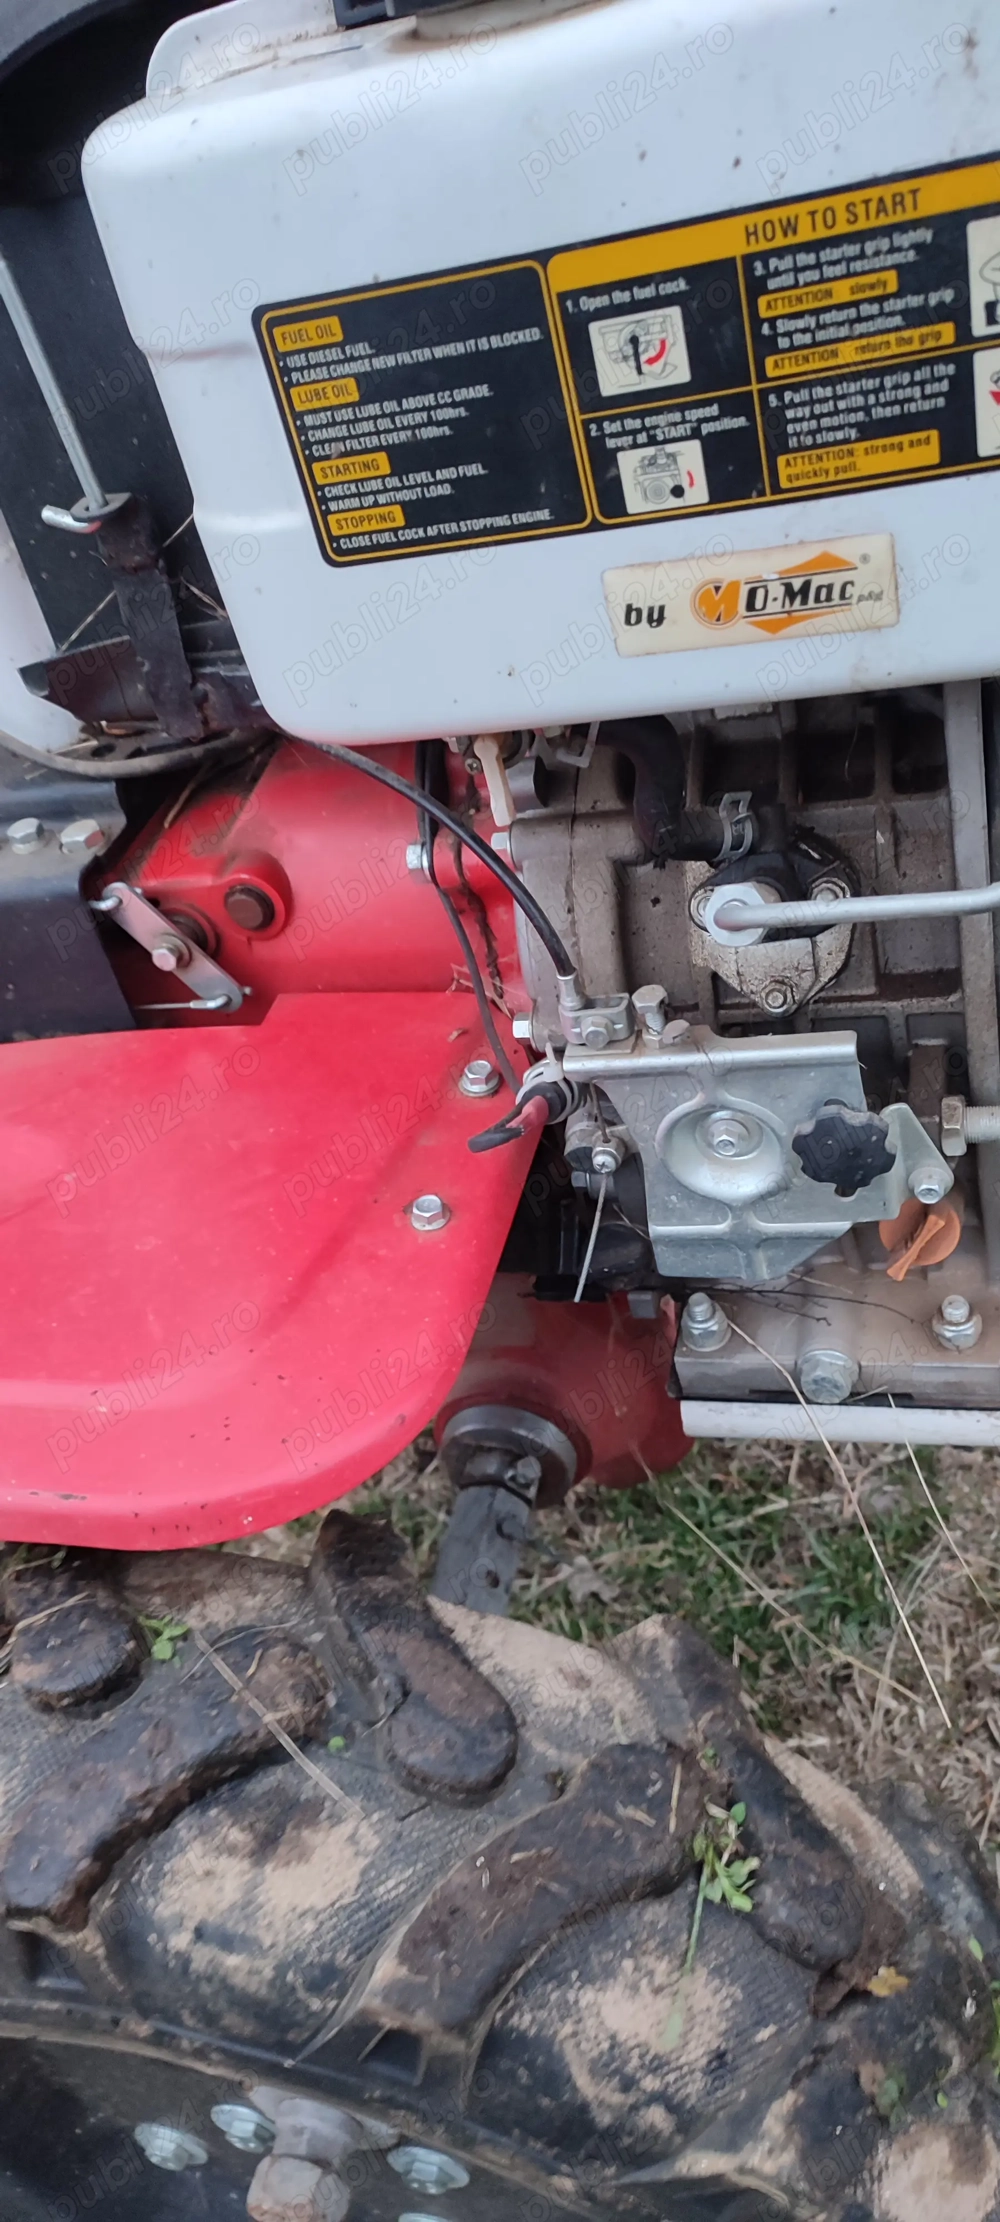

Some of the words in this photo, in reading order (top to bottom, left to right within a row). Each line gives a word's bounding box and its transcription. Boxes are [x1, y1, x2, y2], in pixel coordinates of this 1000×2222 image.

[745, 214, 799, 247] HOW
[807, 206, 837, 232] TO
[845, 188, 921, 225] START
[753, 260, 766, 277] 3.
[768, 254, 794, 273] Pull
[795, 252, 817, 266] the
[819, 243, 862, 263] starter
[864, 236, 891, 255] grip
[766, 271, 795, 290] until
[797, 269, 821, 287] you
[822, 260, 848, 279] feel
[566, 299, 578, 314] 1.
[579, 294, 611, 312] Open
[611, 290, 631, 305] the
[633, 283, 656, 300] fuel
[765, 287, 833, 312] ATTENTION
[849, 278, 888, 296] slowly
[761, 322, 774, 336] 4.
[776, 314, 817, 334] Slowly
[819, 307, 858, 325] return
[859, 302, 881, 317] the
[882, 294, 925, 313] starter
[927, 288, 955, 307] grip
[281, 328, 313, 346] FUEL
[315, 324, 337, 339] OIL
[772, 347, 839, 371] ATTENTION
[854, 338, 891, 355] return
[918, 328, 942, 346] grip
[777, 335, 790, 349] to
[792, 331, 813, 347] the
[814, 323, 850, 342] initial
[286, 353, 306, 368] USE
[308, 347, 345, 364] DIESEL
[344, 342, 376, 358] FUEL.
[291, 365, 329, 384] PLEASE
[329, 359, 372, 377] CHANGE
[371, 354, 396, 369] NEW
[396, 348, 432, 365] FILTER
[432, 342, 465, 359] WHEN
[465, 339, 476, 353] IT
[477, 336, 489, 351] IS
[490, 327, 544, 349] BLOCKED.
[297, 388, 330, 404] LUBE
[332, 384, 353, 398] OIL
[784, 389, 810, 405] Pull
[812, 383, 834, 400] the
[835, 376, 881, 397] starter
[883, 371, 911, 390] grip
[913, 366, 932, 382] all
[933, 362, 956, 378] the
[785, 405, 811, 420] way
[813, 400, 835, 415] out
[836, 394, 865, 411] with
[867, 394, 877, 405] a
[878, 383, 922, 403] strong
[924, 378, 950, 396] and
[303, 411, 333, 427] MUST
[334, 407, 354, 421] USE
[355, 403, 382, 419] LUBE
[383, 400, 400, 414] OIL
[402, 393, 437, 410] ABOVE
[437, 390, 452, 404] CC
[453, 384, 494, 402] GRADE.
[589, 424, 602, 437] 2.
[603, 420, 622, 435] Set
[624, 418, 642, 431] the
[644, 410, 683, 427] engine
[684, 403, 719, 421] speed
[786, 418, 818, 434] even
[871, 403, 902, 420] then
[903, 396, 946, 414] return
[308, 425, 349, 442] CHANGE
[349, 421, 376, 439] LUBE
[377, 417, 394, 431] OIL
[395, 411, 428, 428] EVERY
[345, 435, 380, 450] FILTER
[380, 430, 413, 446] EVERY
[605, 434, 634, 449] lever
[636, 431, 648, 444] at
[701, 416, 751, 436] position.
[788, 436, 799, 449] it
[863, 439, 904, 456] strong
[908, 434, 931, 448] and
[320, 458, 380, 479] STARTING
[324, 482, 358, 498] CHECK
[358, 478, 384, 493] LUBE
[384, 476, 402, 488] OIL
[403, 471, 434, 486] LEVEL
[435, 467, 458, 481] AND
[458, 463, 489, 478] FUEL.
[786, 465, 829, 484] quickly
[328, 497, 360, 512] WARM
[361, 494, 376, 507] UP
[376, 487, 421, 505] WITHOUT
[424, 483, 455, 498] LOAD.
[335, 511, 396, 531] STOPPING
[340, 535, 371, 550] CLOSE
[372, 532, 397, 545] FUEL
[398, 528, 426, 542] COCK
[427, 522, 459, 536] AFTER
[459, 514, 511, 532] STOPPING
[624, 603, 666, 628] by
